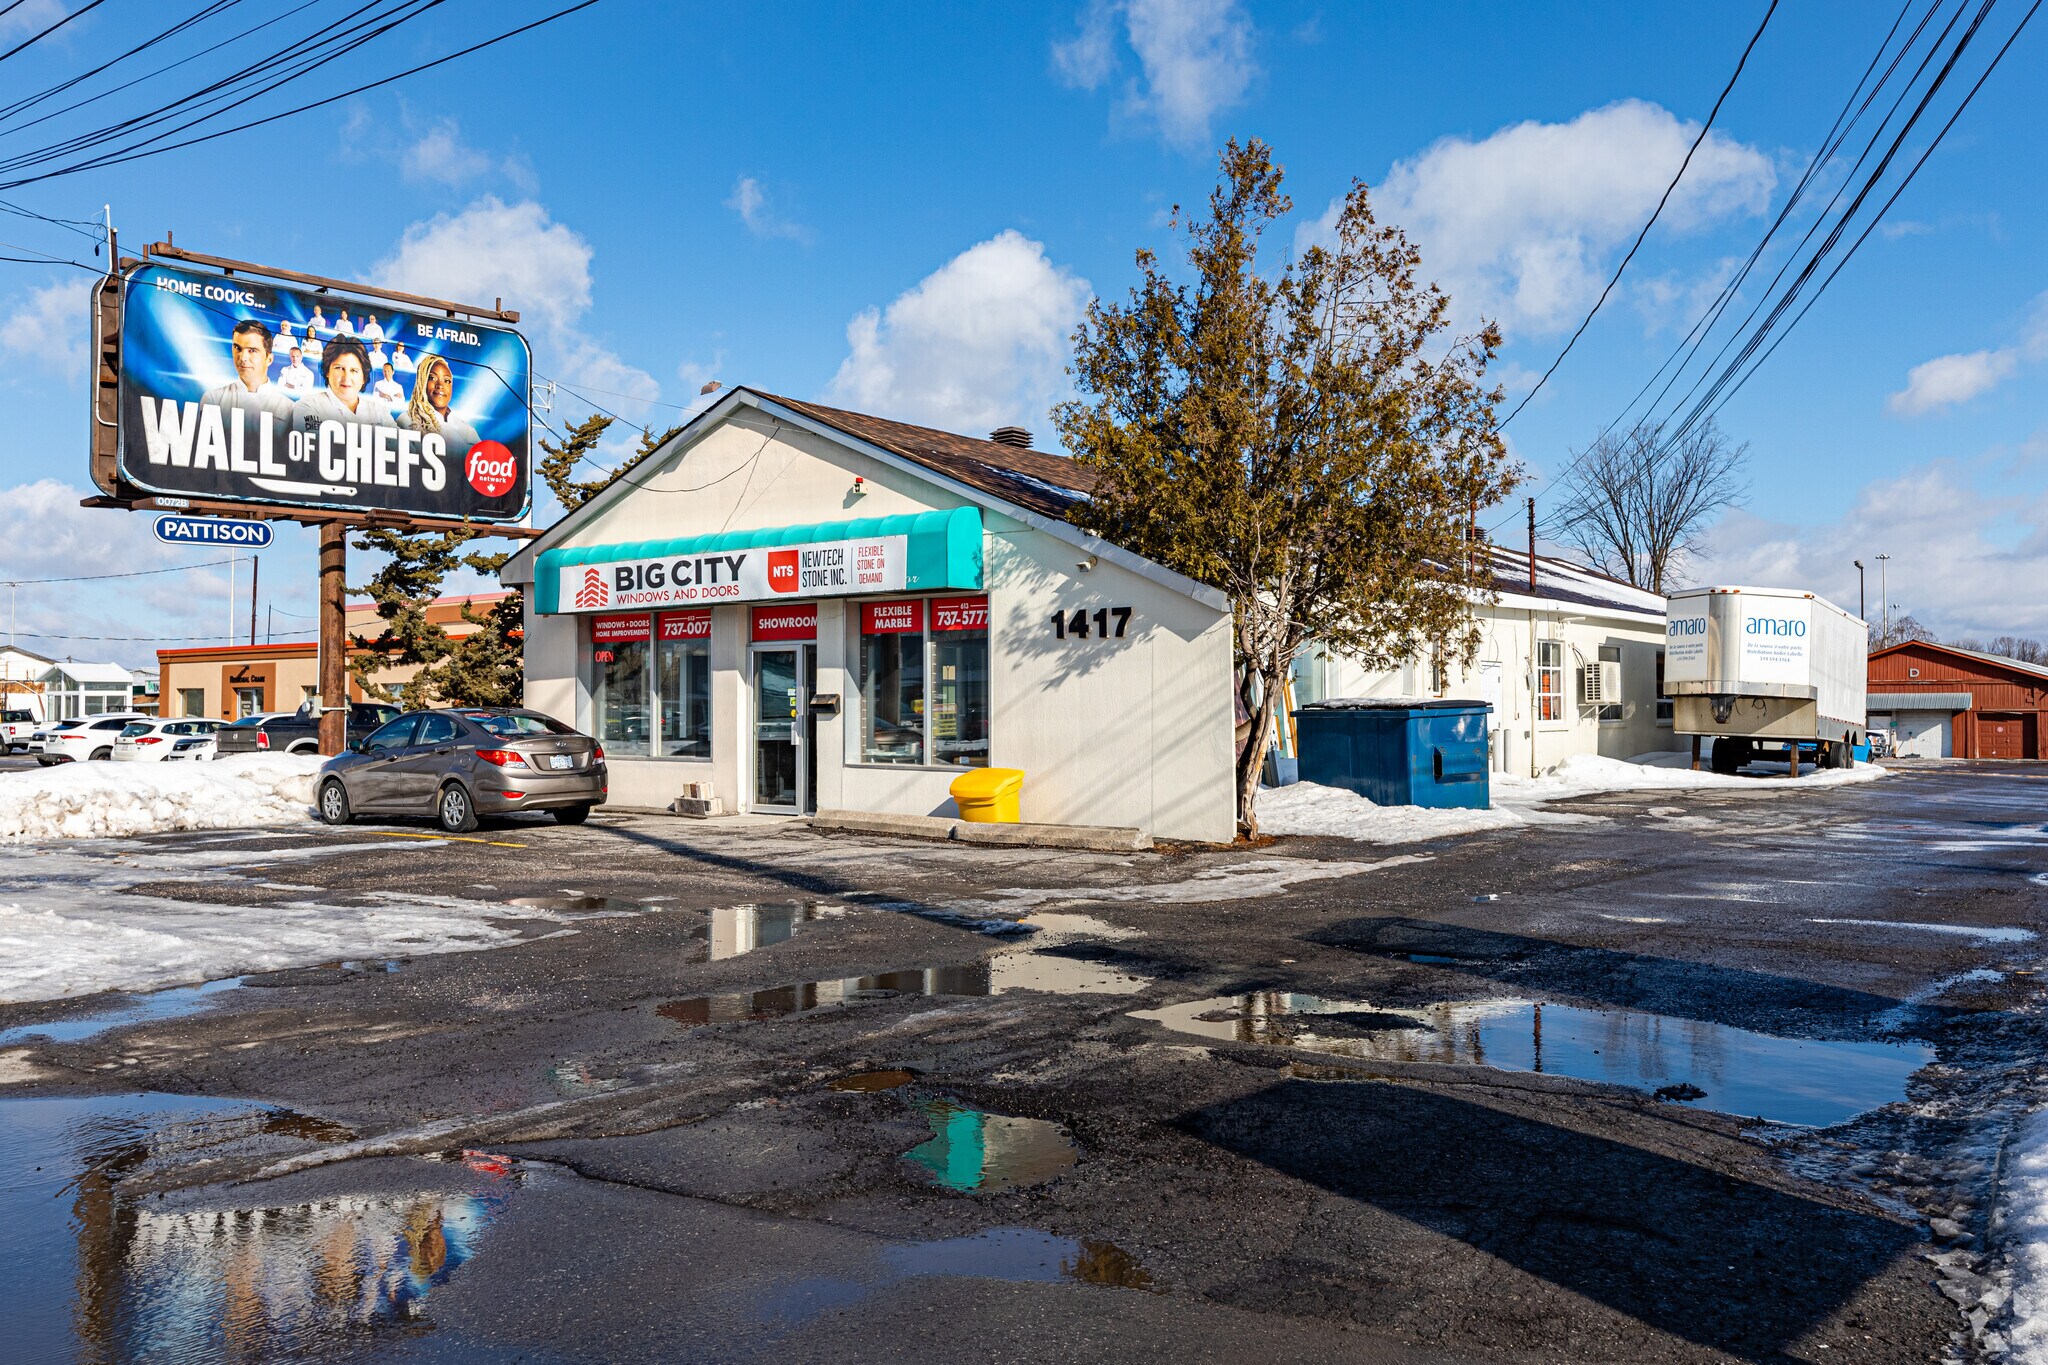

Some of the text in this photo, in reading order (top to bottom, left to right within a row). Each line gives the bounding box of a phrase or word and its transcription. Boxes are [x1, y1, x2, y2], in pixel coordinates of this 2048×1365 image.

[157, 276, 266, 309] HOME COOKS...
[417, 323, 481, 347] BE AFRAID.
[140, 396, 447, 492] WALL OF CHEFS
[468, 451, 516, 483] food
[479, 475, 507, 484] network
[157, 496, 188, 508] 0072B
[164, 520, 264, 543] PATTISON
[802, 548, 844, 568] NEWTECH
[858, 545, 884, 557] FLEXIBLE
[857, 557, 885, 571] STONE ON
[615, 553, 747, 592] BIG CITY
[773, 565, 794, 578] NTS
[802, 567, 848, 588] STONE INC.
[858, 572, 883, 584] DEMAND
[616, 584, 740, 605] WINDOWS AND DOORS
[874, 605, 912, 617] FLEXIBLE
[960, 602, 969, 610] 613
[596, 619, 650, 629] WINDOWS DOORS
[875, 617, 912, 629] MARBLE
[1051, 606, 1134, 640] 1417
[1669, 617, 1706, 637] amaro
[1746, 617, 1806, 637] amaro
[595, 628, 650, 638] HOME IMPROVEMENTS
[595, 650, 614, 663] OPEN
[1909, 668, 1920, 678] D
